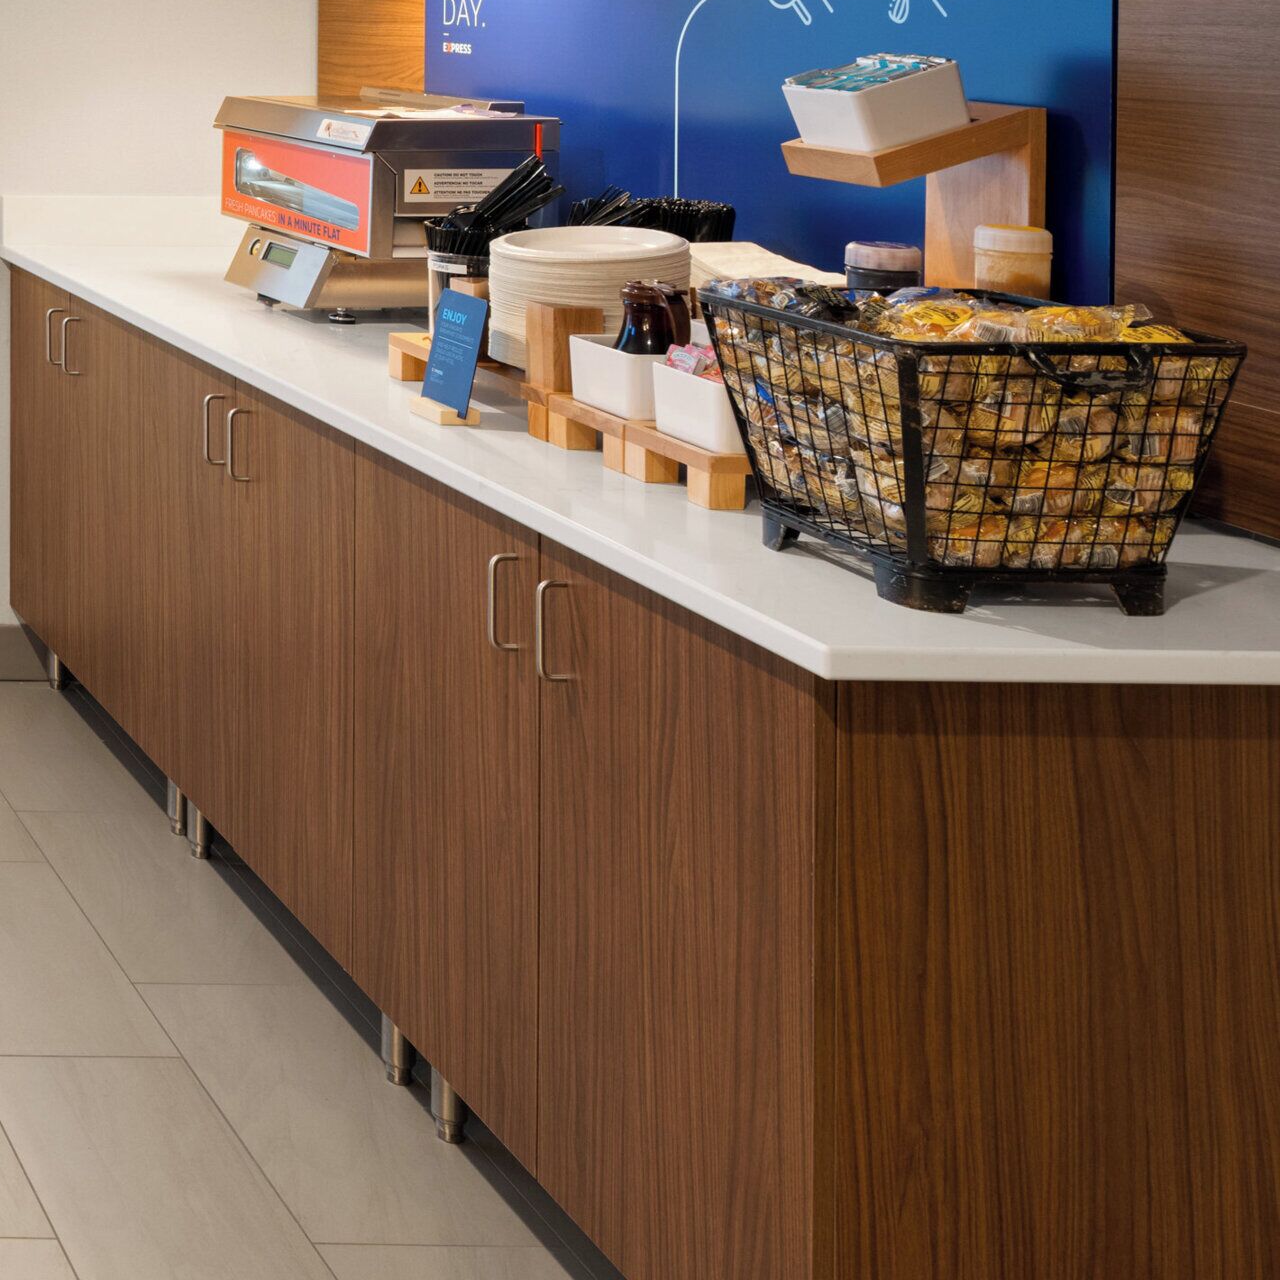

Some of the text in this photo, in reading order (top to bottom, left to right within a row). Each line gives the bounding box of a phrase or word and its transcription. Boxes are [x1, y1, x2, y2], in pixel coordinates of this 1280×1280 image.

[443, 42, 472, 54] EXPRESS
[278, 213, 286, 225] IN
[287, 216, 293, 227] A
[294, 218, 321, 236] MINUTE
[323, 226, 341, 240] FLAT
[442, 308, 468, 325] ENJOY
